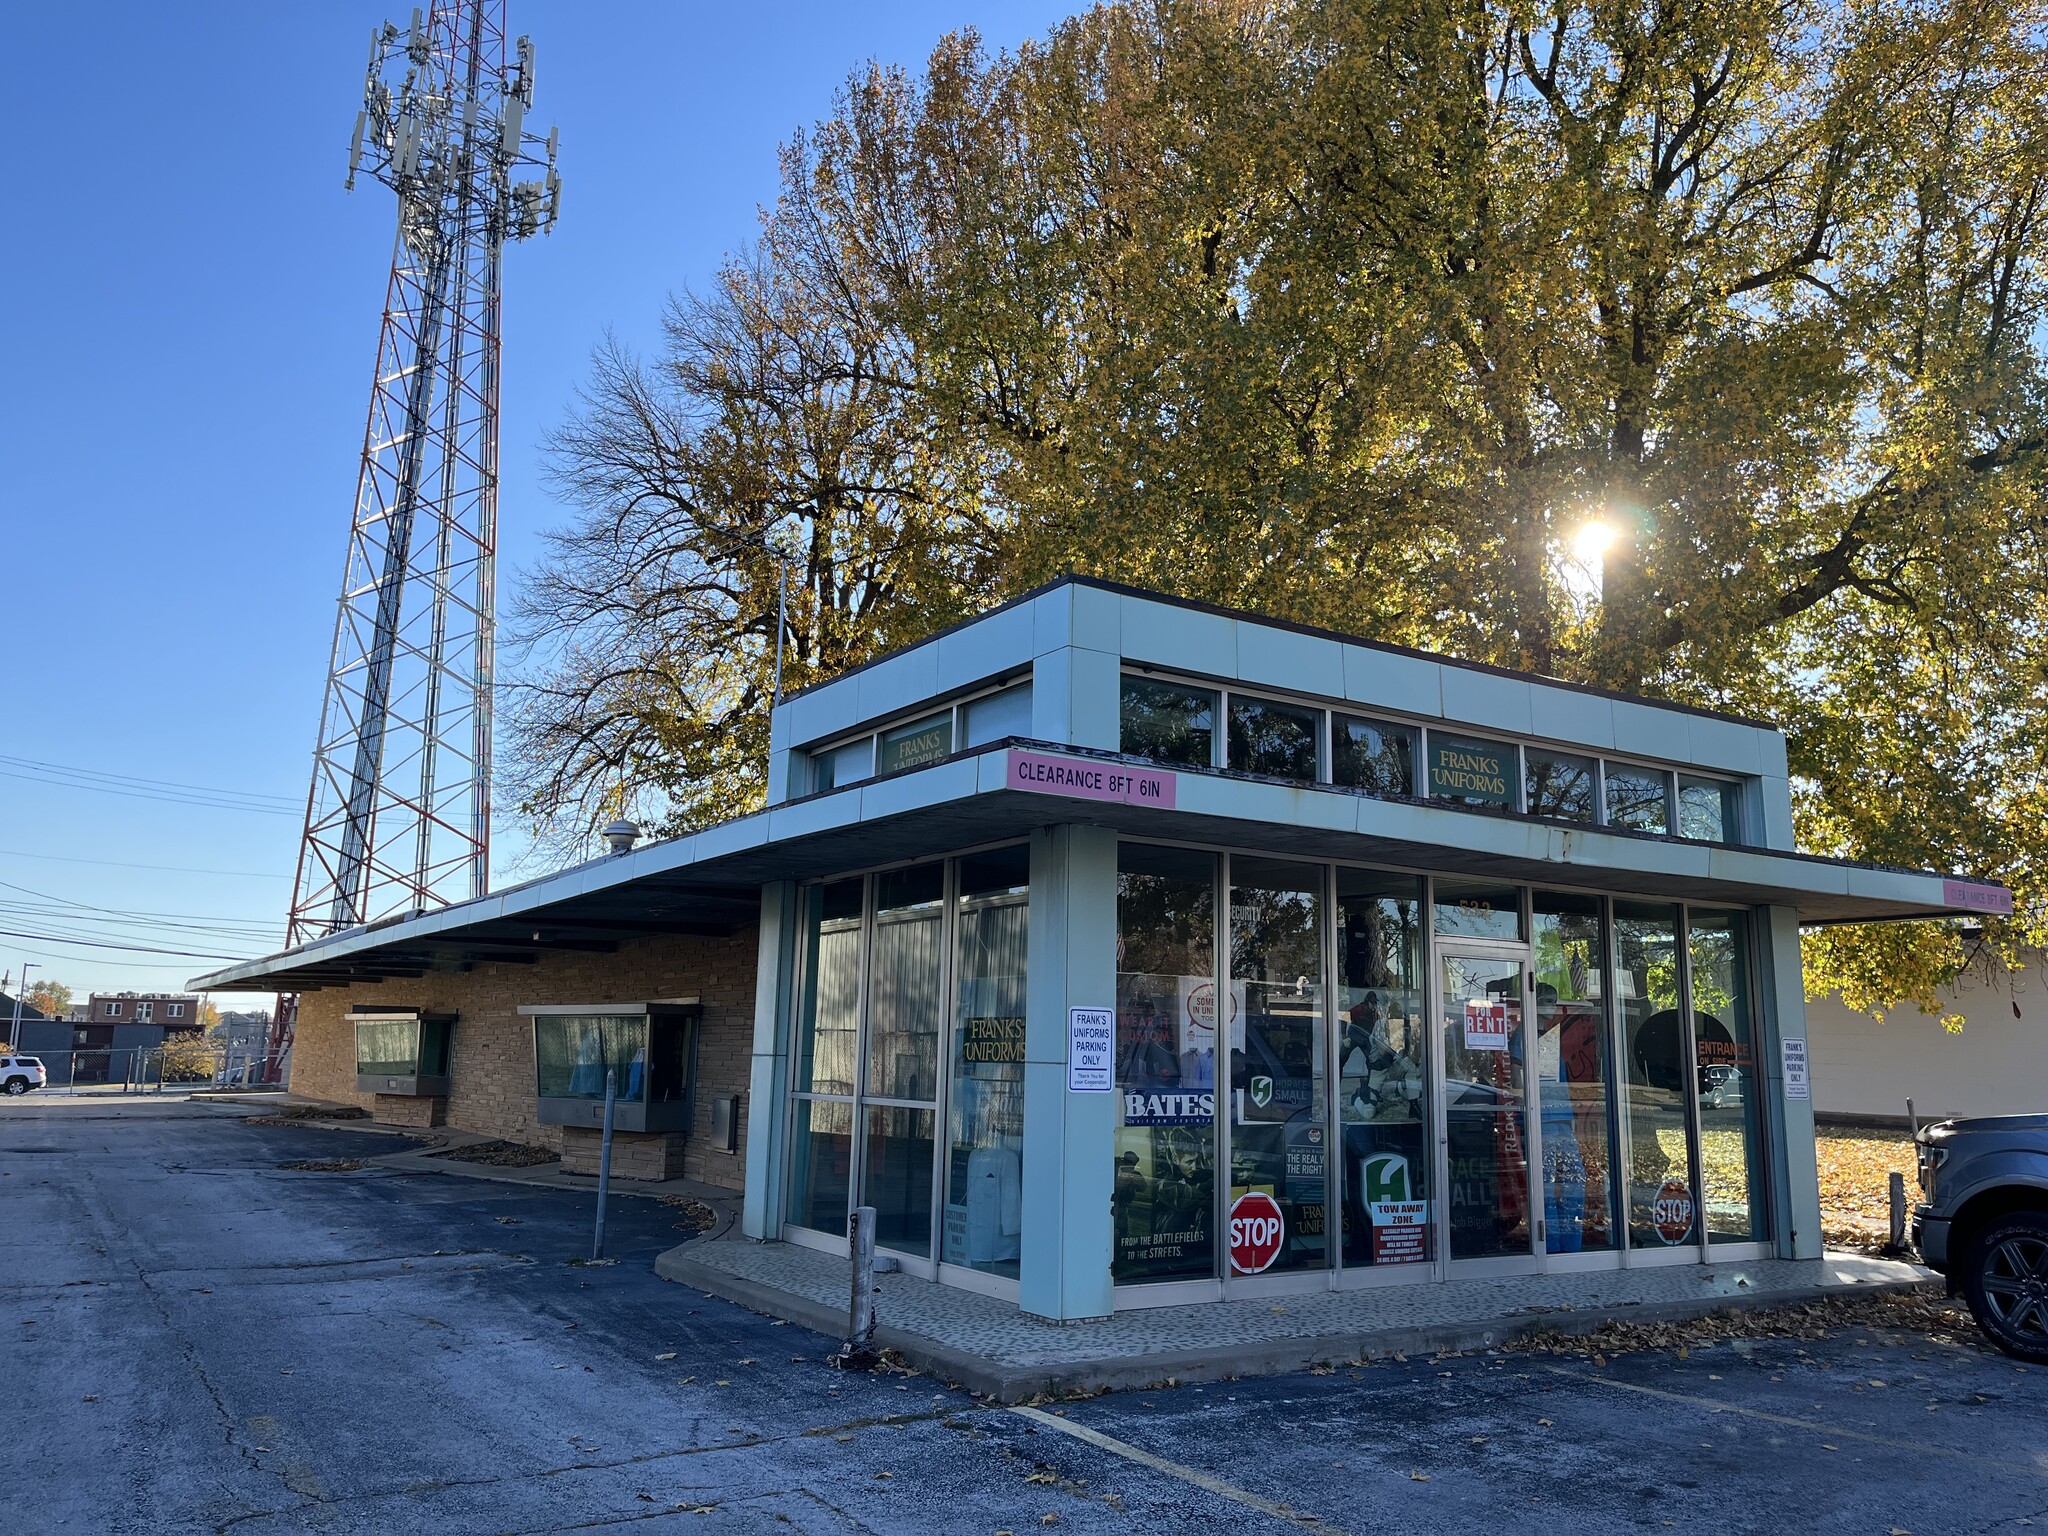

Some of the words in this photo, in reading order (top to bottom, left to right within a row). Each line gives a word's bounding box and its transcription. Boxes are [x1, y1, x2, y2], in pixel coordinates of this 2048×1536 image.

[899, 731, 940, 758] FRANKS
[1440, 750, 1499, 775] FRANKS
[1018, 761, 1102, 790] CLEARANCE
[1109, 776, 1133, 794] 8FT
[1139, 779, 1160, 798] 6IN
[1432, 768, 1505, 795] UNIFORMS
[1476, 1007, 1491, 1017] FOR
[1077, 1014, 1106, 1025] FRANK'S
[1467, 1016, 1503, 1033] RENT
[972, 1019, 1021, 1038] FRANKS
[1074, 1028, 1109, 1039] UNIFORMS
[964, 1041, 1025, 1061] UNIFORMS
[1076, 1042, 1107, 1052] PARKING
[1698, 1041, 1749, 1056] ENTRANCE
[1785, 1043, 1802, 1051] FRANK'S
[1082, 1055, 1100, 1065] ONLY
[1700, 1057, 1709, 1065] ON
[1787, 1063, 1803, 1072] PARKING
[1124, 1094, 1214, 1117] BATES
[1287, 1154, 1300, 1164] THE
[1302, 1154, 1318, 1164] REAL
[1287, 1164, 1300, 1174] THE
[1302, 1166, 1323, 1175] RIGHT
[1378, 1205, 1398, 1214] TOW
[1401, 1204, 1424, 1213] AWAY
[1656, 1199, 1691, 1223] STOP
[1392, 1216, 1413, 1224] ZONE
[1231, 1217, 1279, 1248] STOP
[1121, 1237, 1138, 1247] FROM
[1140, 1236, 1151, 1246] THE
[1153, 1230, 1204, 1245] BATTLEFIELDS
[1128, 1251, 1135, 1260] TO
[1136, 1250, 1148, 1259] THE
